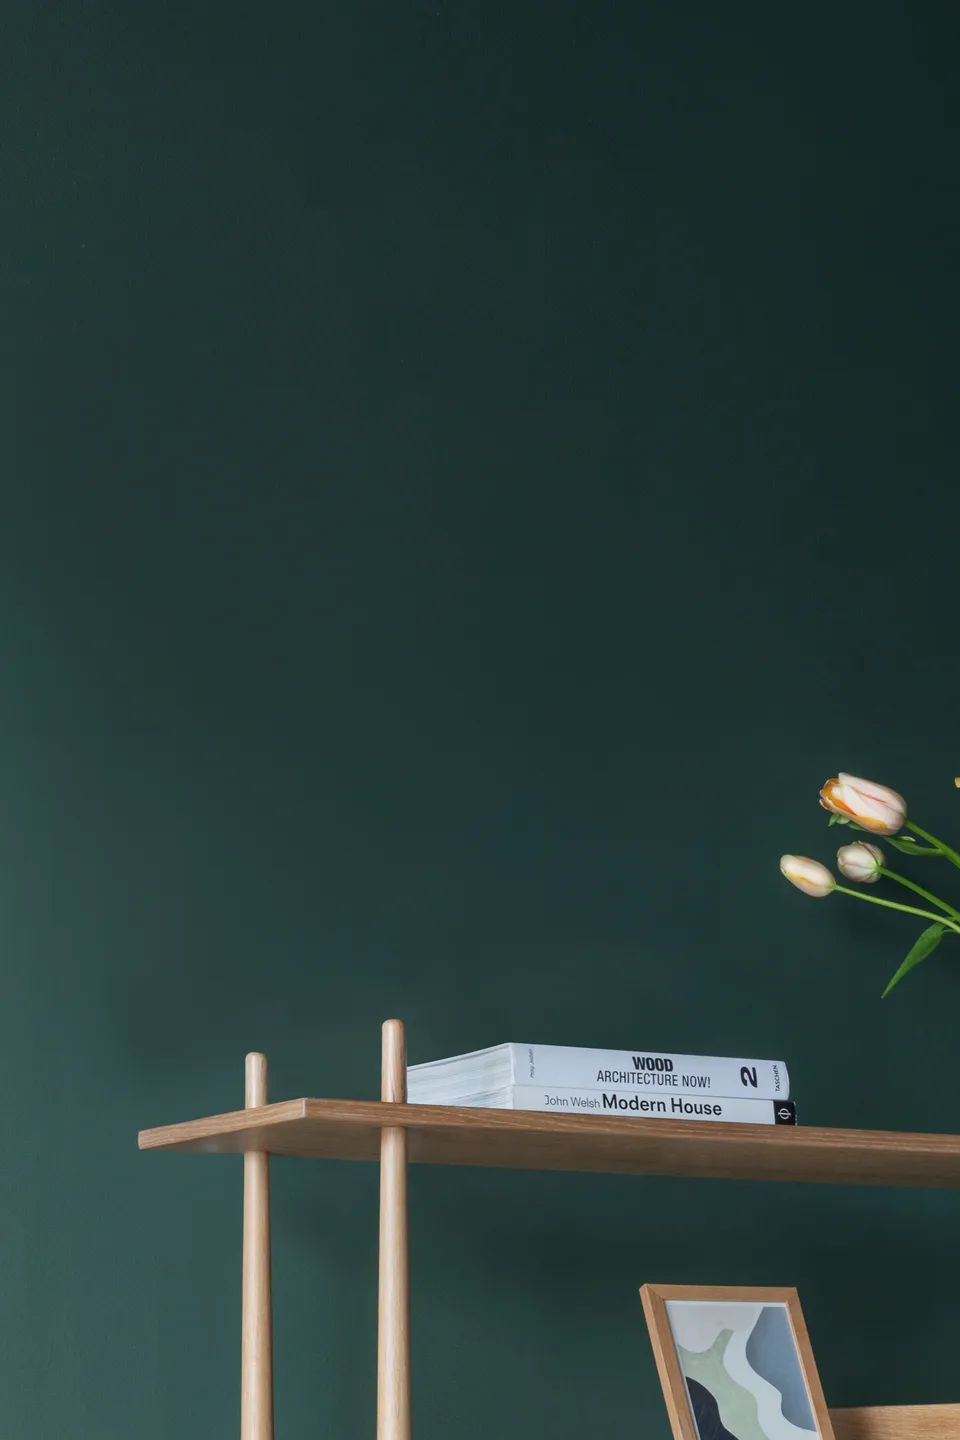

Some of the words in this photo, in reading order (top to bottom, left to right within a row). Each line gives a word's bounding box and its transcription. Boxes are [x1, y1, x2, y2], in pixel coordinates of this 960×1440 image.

[632, 1056, 674, 1072] WOOD
[597, 1070, 679, 1087] ARCHITECTURE
[682, 1075, 711, 1088] NOW!
[740, 1066, 758, 1088] 2
[772, 1065, 781, 1092] TASCHEN
[544, 1095, 569, 1107] John
[570, 1096, 600, 1108] Welsh
[602, 1093, 666, 1112] Modern
[671, 1098, 722, 1115] House
